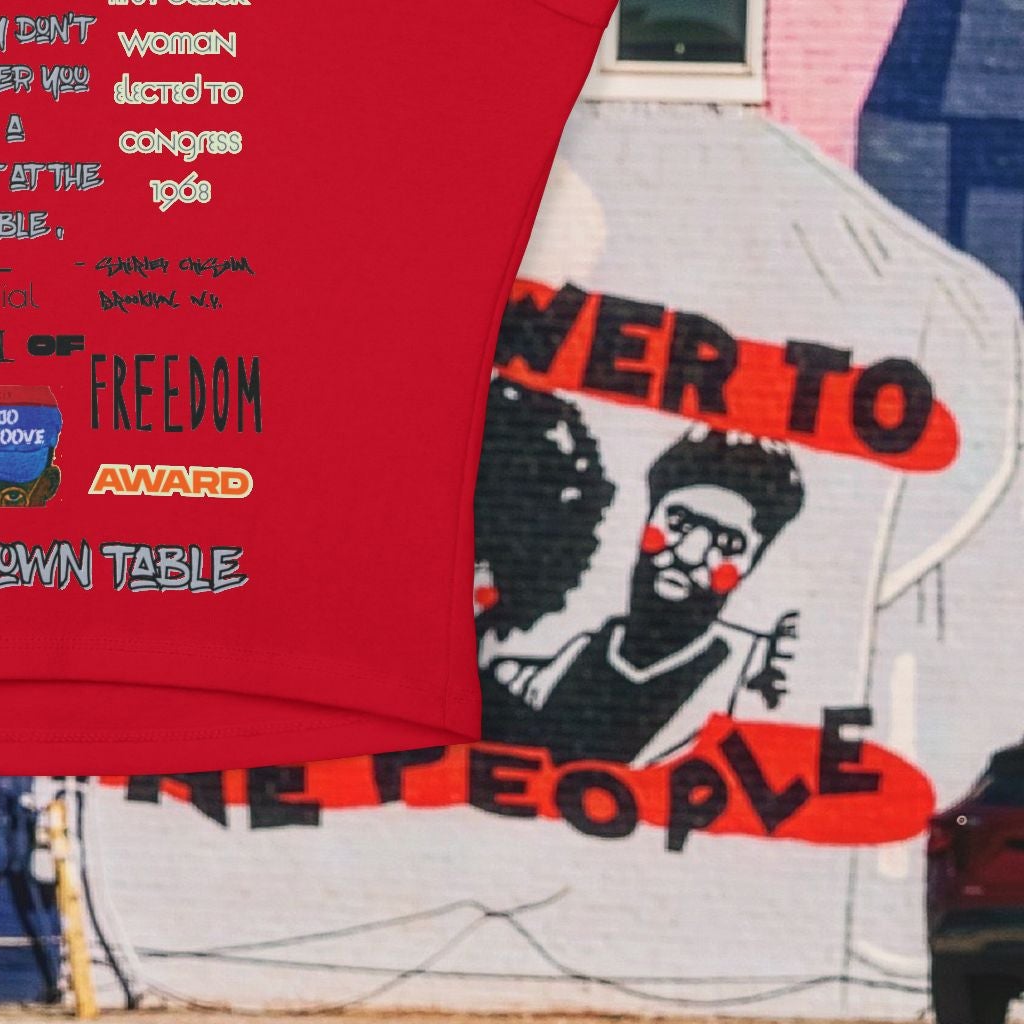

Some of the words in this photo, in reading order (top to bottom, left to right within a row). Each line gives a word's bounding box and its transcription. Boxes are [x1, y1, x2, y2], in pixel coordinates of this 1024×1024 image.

[15, 11, 97, 45] DON'T
[117, 28, 237, 58] woman
[40, 64, 90, 102] YOU
[204, 81, 244, 104] TO
[5, 113, 26, 143] A
[119, 128, 243, 162] congress
[9, 162, 47, 192] AT
[47, 162, 105, 192] THE
[149, 170, 212, 213] 1968
[27, 334, 85, 357] OF
[494, 282, 738, 418] WER
[785, 339, 934, 454] TO
[90, 353, 263, 434] FREEDOM
[88, 464, 254, 499] AWARD
[99, 541, 250, 593] TABLE
